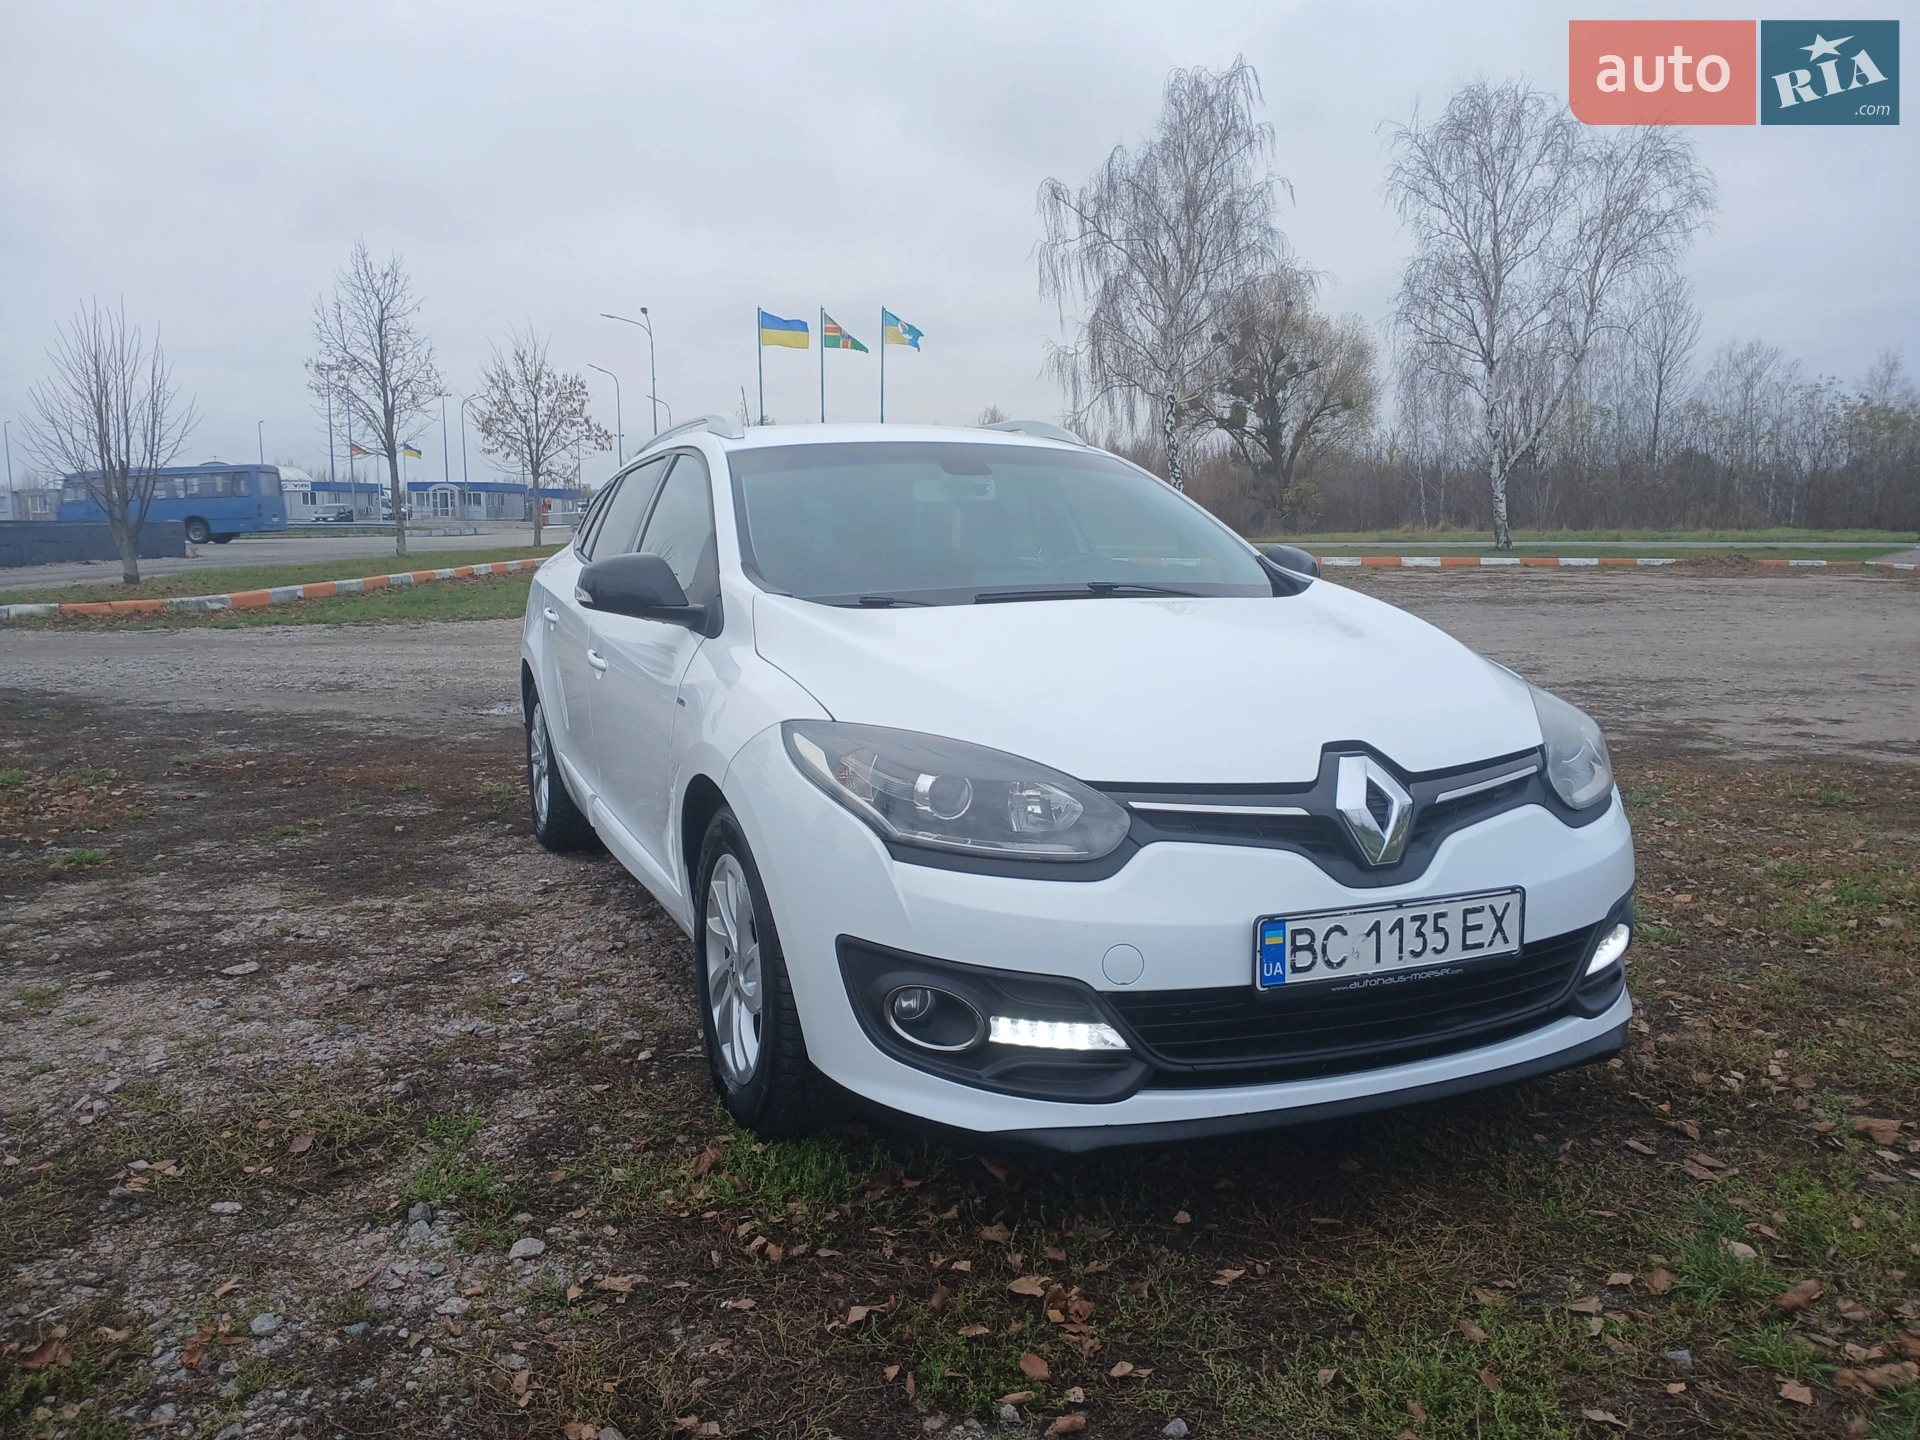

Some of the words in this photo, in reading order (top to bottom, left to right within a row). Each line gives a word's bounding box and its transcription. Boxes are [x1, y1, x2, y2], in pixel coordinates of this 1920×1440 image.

[1290, 925, 1348, 973] BC
[1364, 912, 1449, 964] 1135
[1461, 901, 1511, 951] EX
[1264, 961, 1284, 977] UA
[1331, 968, 1463, 991] www.autohaus-moeser.com
